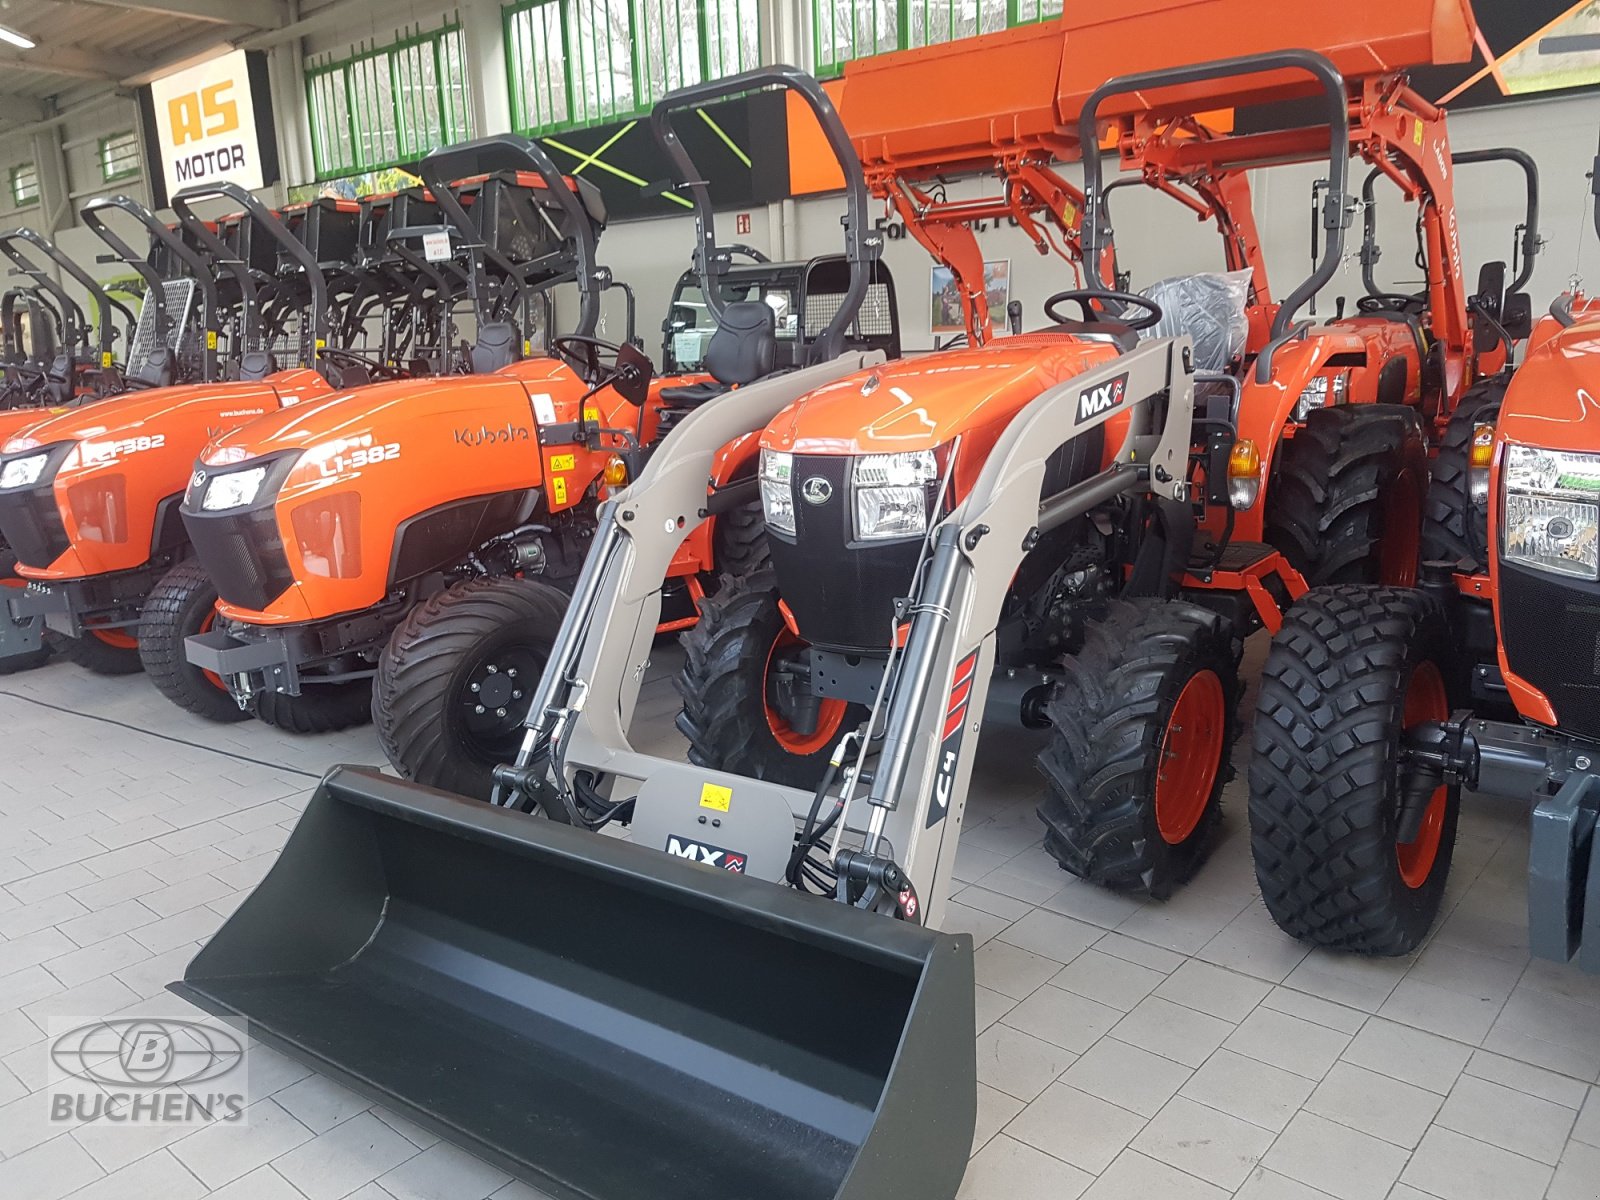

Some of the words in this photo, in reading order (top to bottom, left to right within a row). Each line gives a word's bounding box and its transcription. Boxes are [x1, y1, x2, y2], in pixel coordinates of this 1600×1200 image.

[167, 79, 239, 146] AS
[175, 144, 246, 182] MOTOR
[1449, 207, 1461, 280] Kubota
[1080, 383, 1113, 419] MX
[454, 423, 529, 447] Kubota
[319, 442, 401, 478] L1-382
[936, 751, 956, 808] C4
[667, 838, 725, 867] MX
